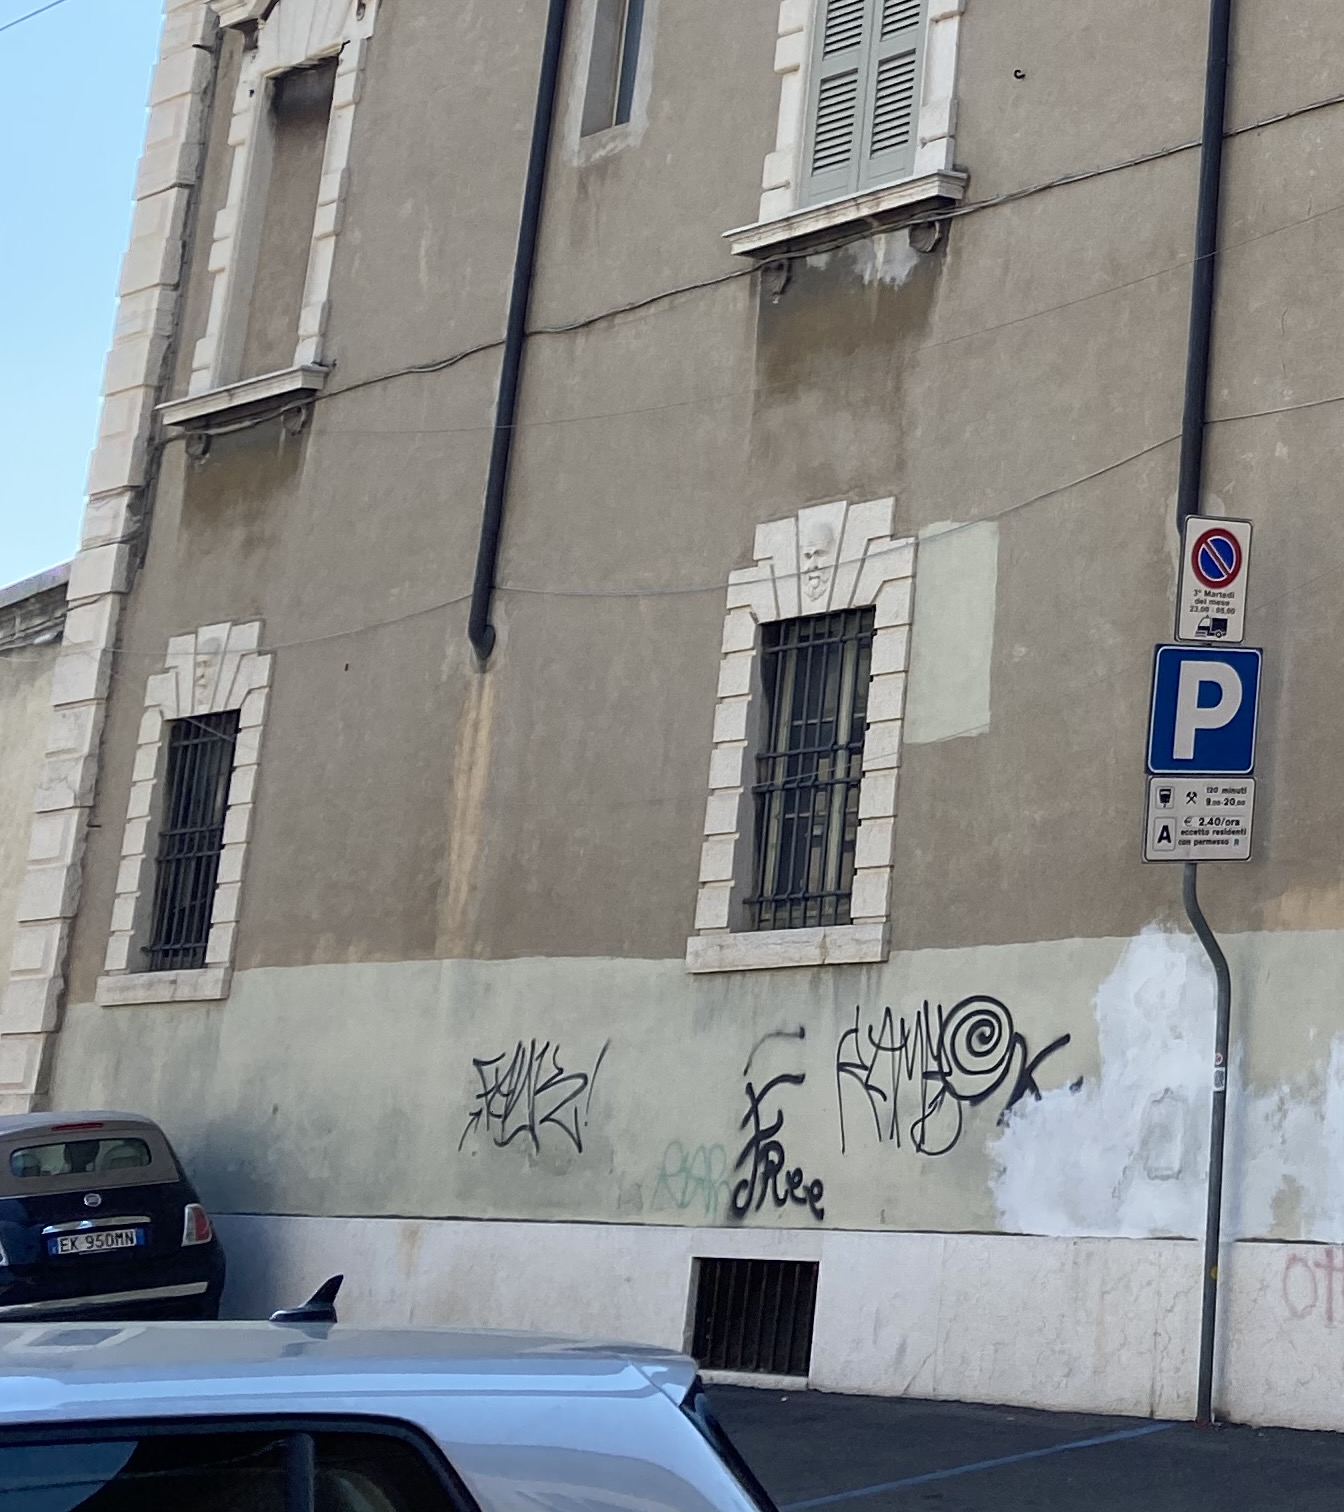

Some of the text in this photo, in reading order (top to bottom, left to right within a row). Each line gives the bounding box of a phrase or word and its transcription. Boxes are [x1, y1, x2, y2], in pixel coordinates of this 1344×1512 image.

[1173, 660, 1242, 759] P
[1221, 786, 1248, 795] minuti
[1157, 824, 1172, 844] A
[1180, 827, 1247, 836] eccetto residenti
[1193, 839, 1229, 847] permesso
[60, 1231, 134, 1253] EK 950MN
